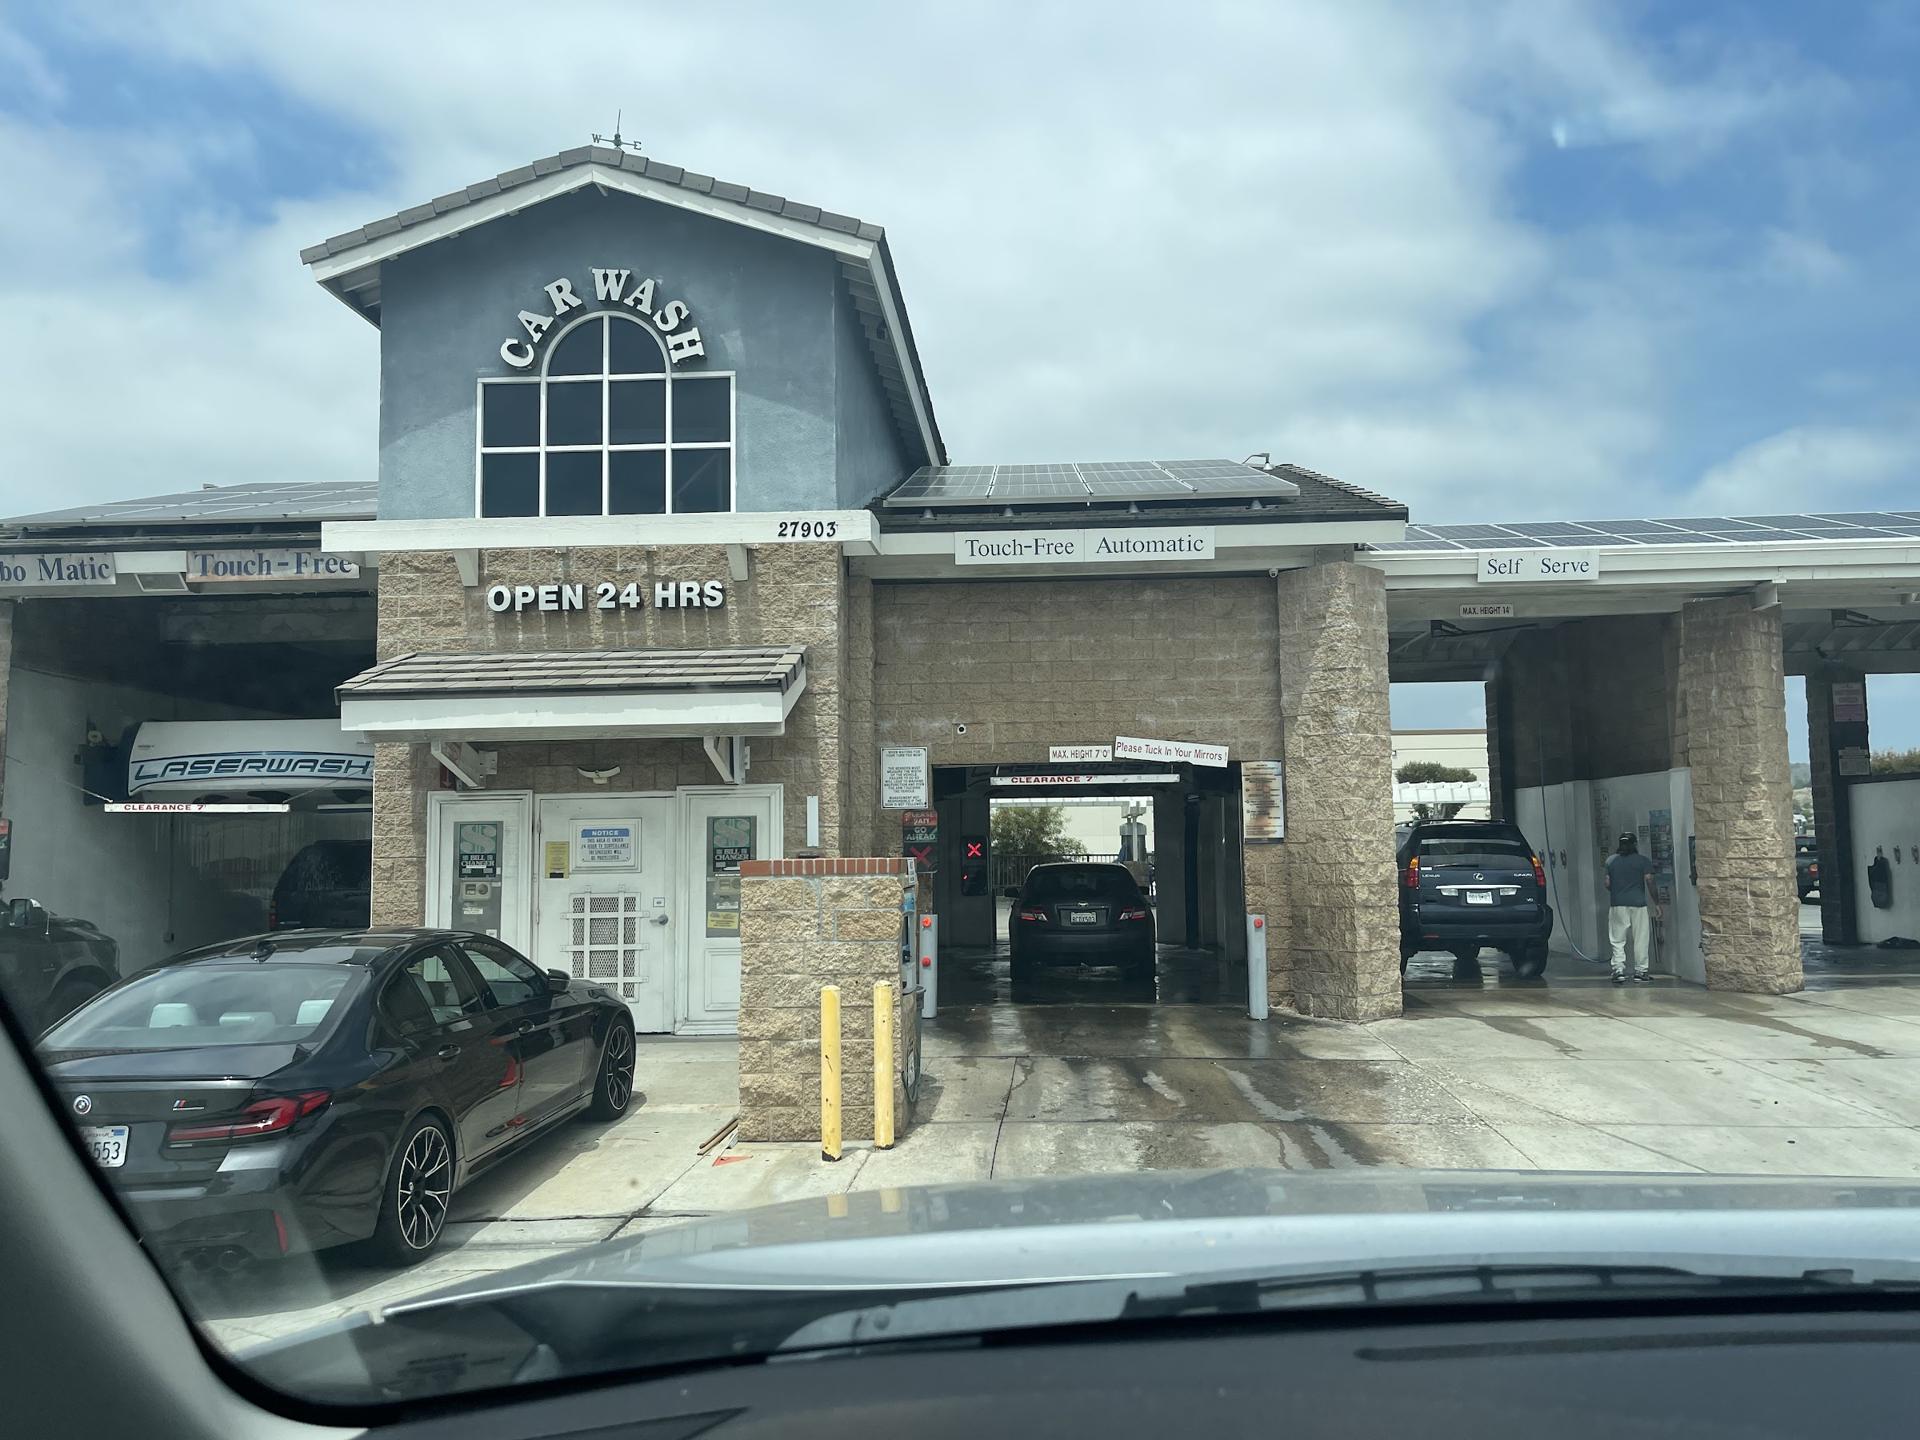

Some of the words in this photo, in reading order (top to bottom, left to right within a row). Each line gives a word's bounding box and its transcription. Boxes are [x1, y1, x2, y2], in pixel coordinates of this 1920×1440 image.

[500, 277, 583, 367] CAR
[591, 268, 705, 364] WASH
[777, 520, 836, 538] 27903
[964, 537, 1075, 557] Touch-Free
[1095, 534, 1204, 554] Automatic
[37, 556, 111, 580] Matic
[1487, 558, 1524, 575] Self
[1540, 557, 1590, 574] Serve
[487, 583, 585, 612] OPEN
[596, 581, 641, 609] 24
[654, 579, 725, 608] HRS
[1480, 606, 1501, 615] HEIGHT
[1070, 749, 1093, 759] HEIGHT
[1116, 741, 1143, 753] Please
[1145, 744, 1163, 755] Tuck
[1164, 745, 1172, 756] In
[1174, 746, 1191, 758] Your
[1193, 749, 1223, 761] Mirrors
[134, 758, 371, 780] LASERWASH
[1011, 776, 1081, 784] CLEARANCE
[906, 833, 936, 841] AHEAD
[87, 1141, 121, 1160] 553
